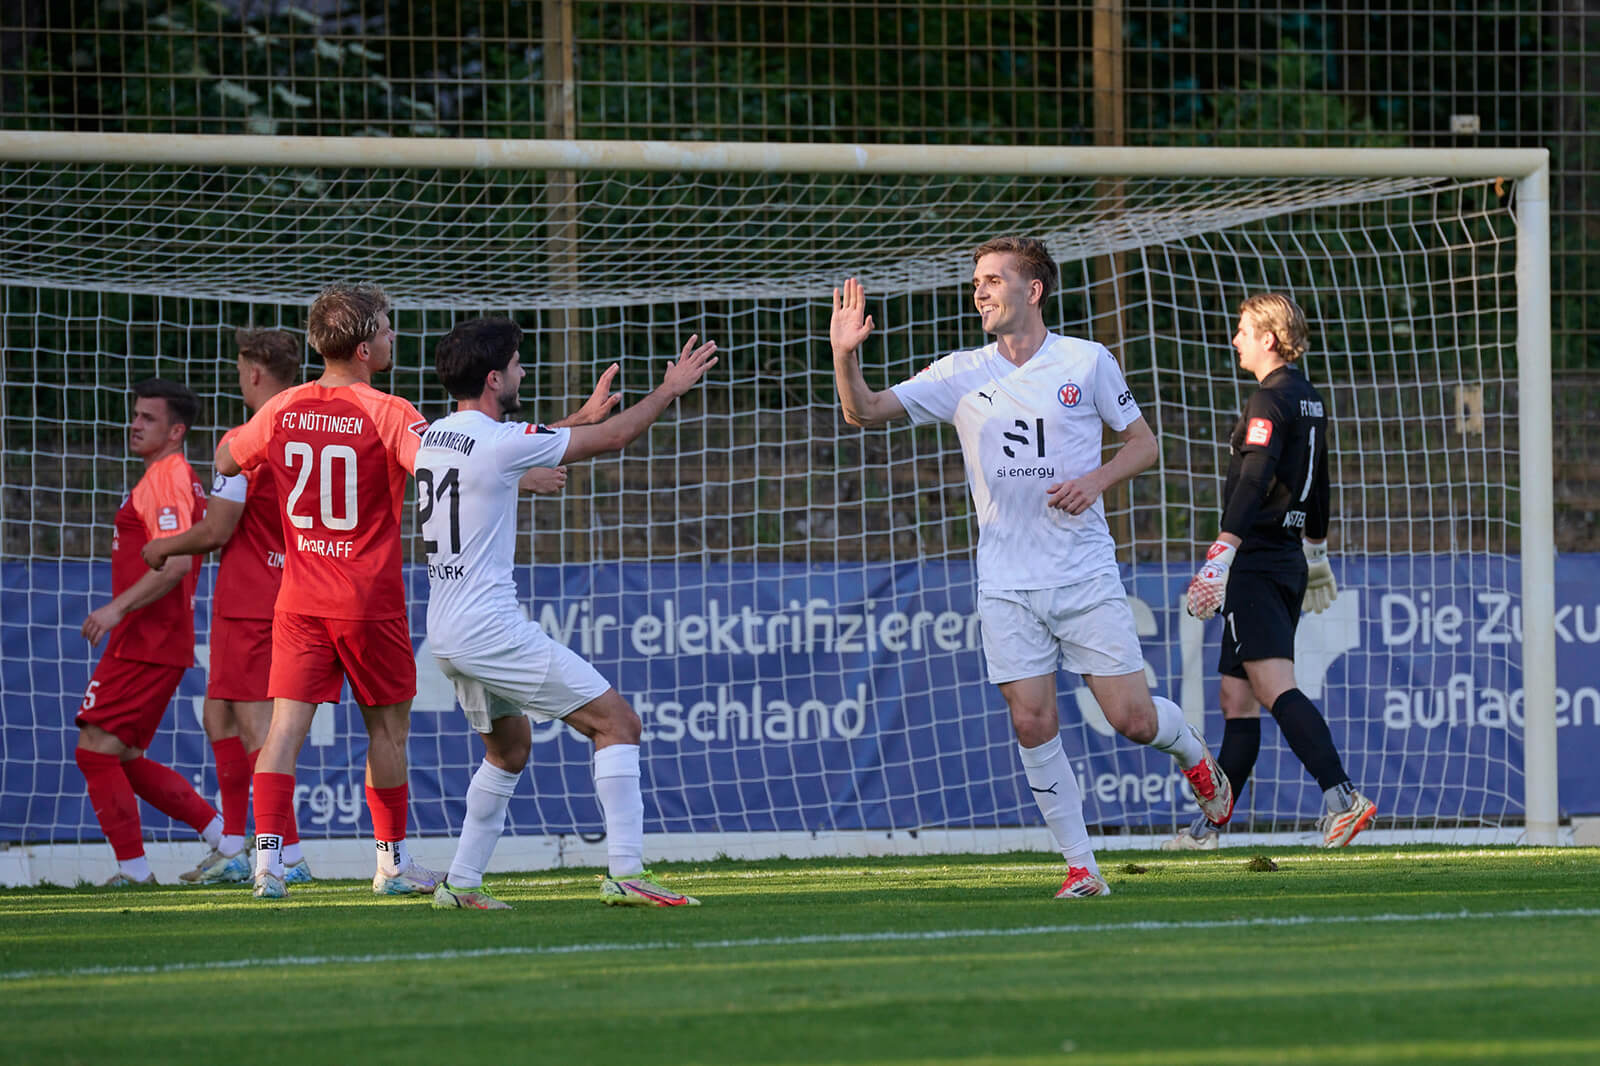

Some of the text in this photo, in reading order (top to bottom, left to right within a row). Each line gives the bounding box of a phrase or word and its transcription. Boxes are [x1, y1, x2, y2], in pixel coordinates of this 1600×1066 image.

[282, 410, 363, 434] FC NÖTTINGEN
[424, 430, 476, 457] MANNHEIM
[284, 441, 359, 530] 20
[996, 465, 1055, 479] si energy
[1299, 426, 1315, 503] 1
[415, 467, 461, 554] 21
[519, 600, 617, 655] Wir
[1381, 591, 1464, 645] Die
[532, 683, 867, 743] tschland
[258, 837, 279, 850] FS
